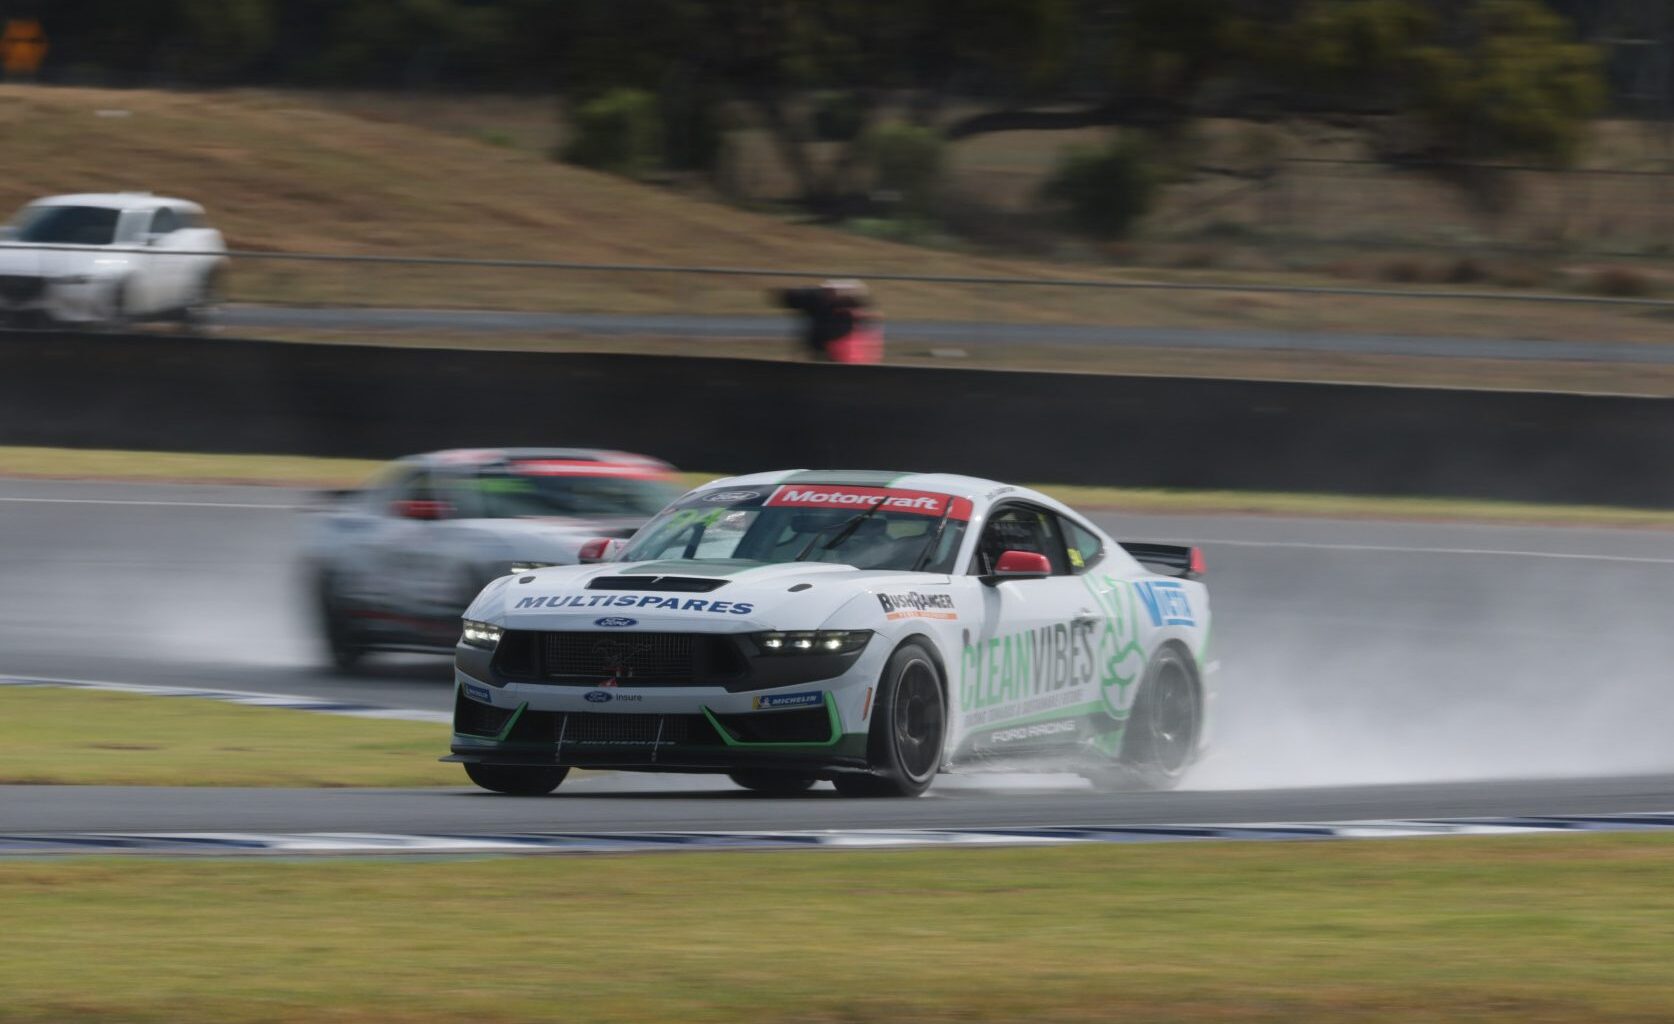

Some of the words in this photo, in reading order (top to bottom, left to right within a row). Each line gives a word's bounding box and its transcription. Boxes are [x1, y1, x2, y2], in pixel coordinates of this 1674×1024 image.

[782, 490, 939, 510] Motorcraft
[514, 595, 754, 615] MULTISPARES
[961, 621, 1095, 712] CLEANVIBES
[772, 696, 817, 705] MICHELIN
[991, 728, 1027, 742] FORD
